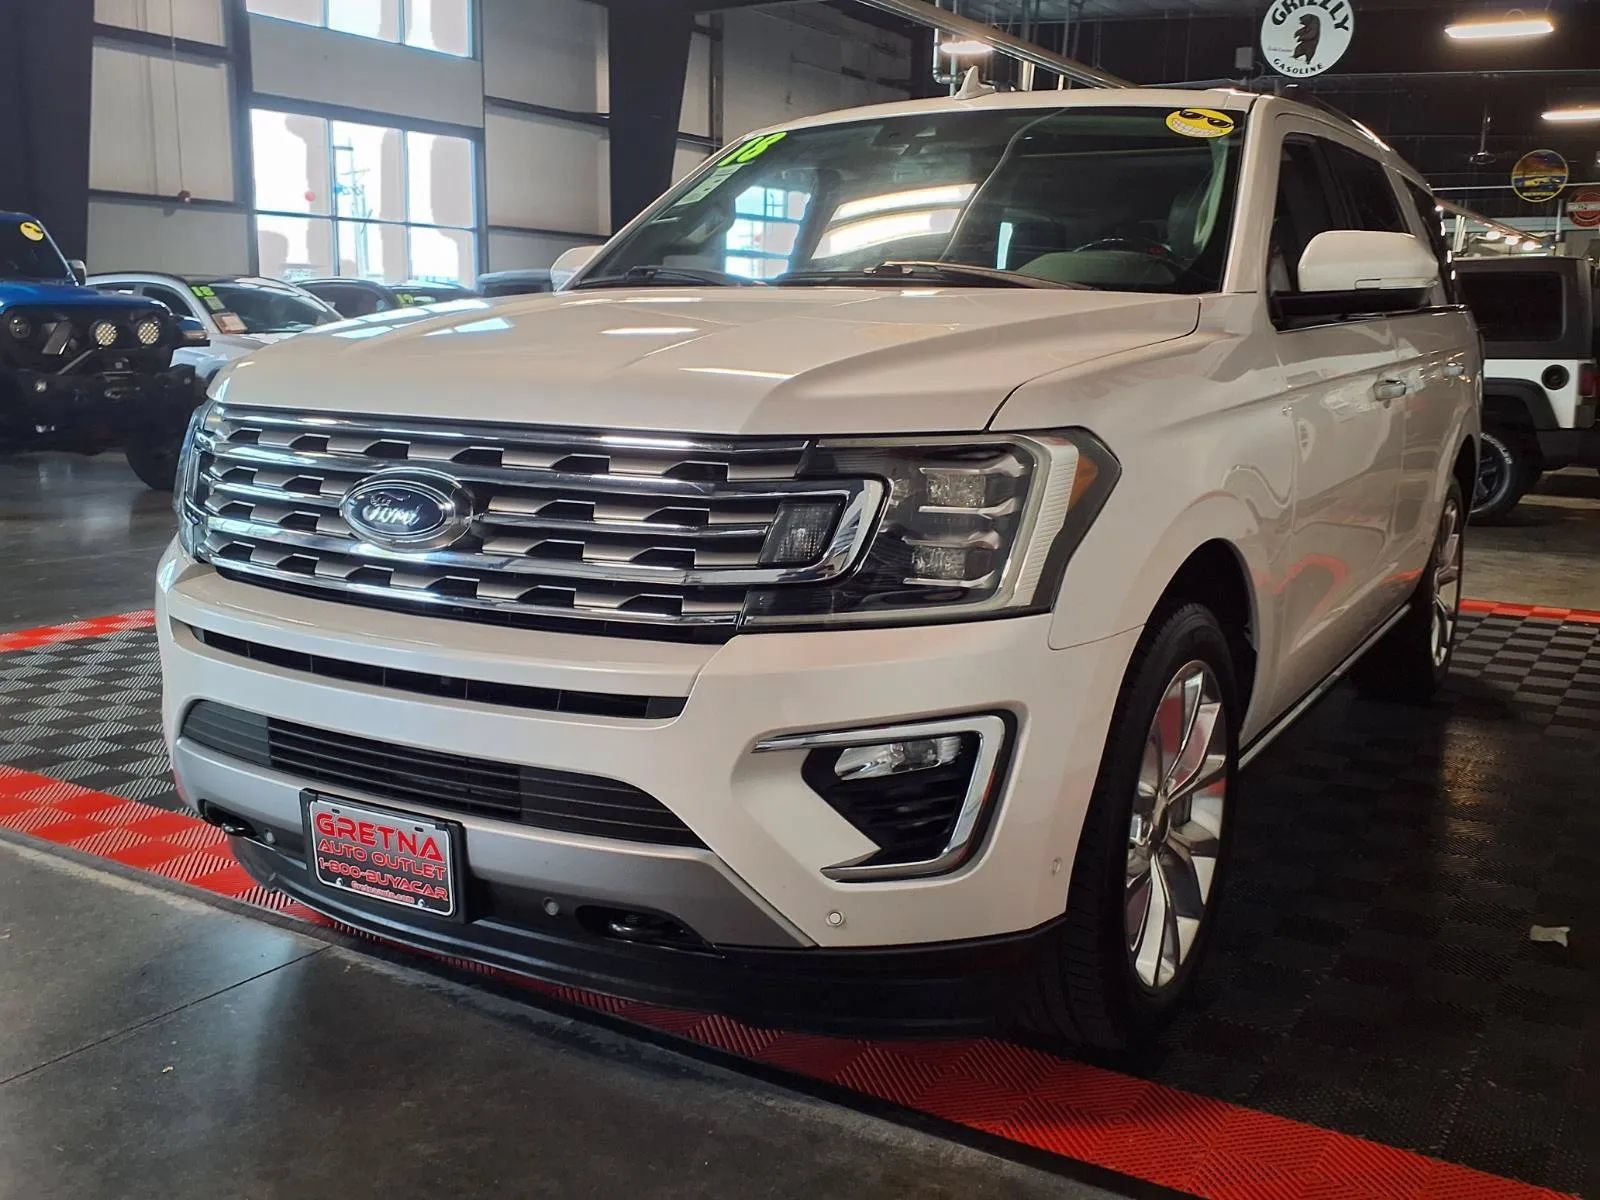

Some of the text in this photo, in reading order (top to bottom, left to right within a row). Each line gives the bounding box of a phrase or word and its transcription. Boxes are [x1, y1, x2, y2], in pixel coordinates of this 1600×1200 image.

[1273, 58, 1323, 75] GASOLINE
[717, 132, 787, 167] 18
[362, 491, 422, 527] Ford
[316, 812, 443, 862] GRETNA
[318, 838, 447, 880] AUTO OUTLET
[318, 857, 449, 902] 1-800-BUYACAR
